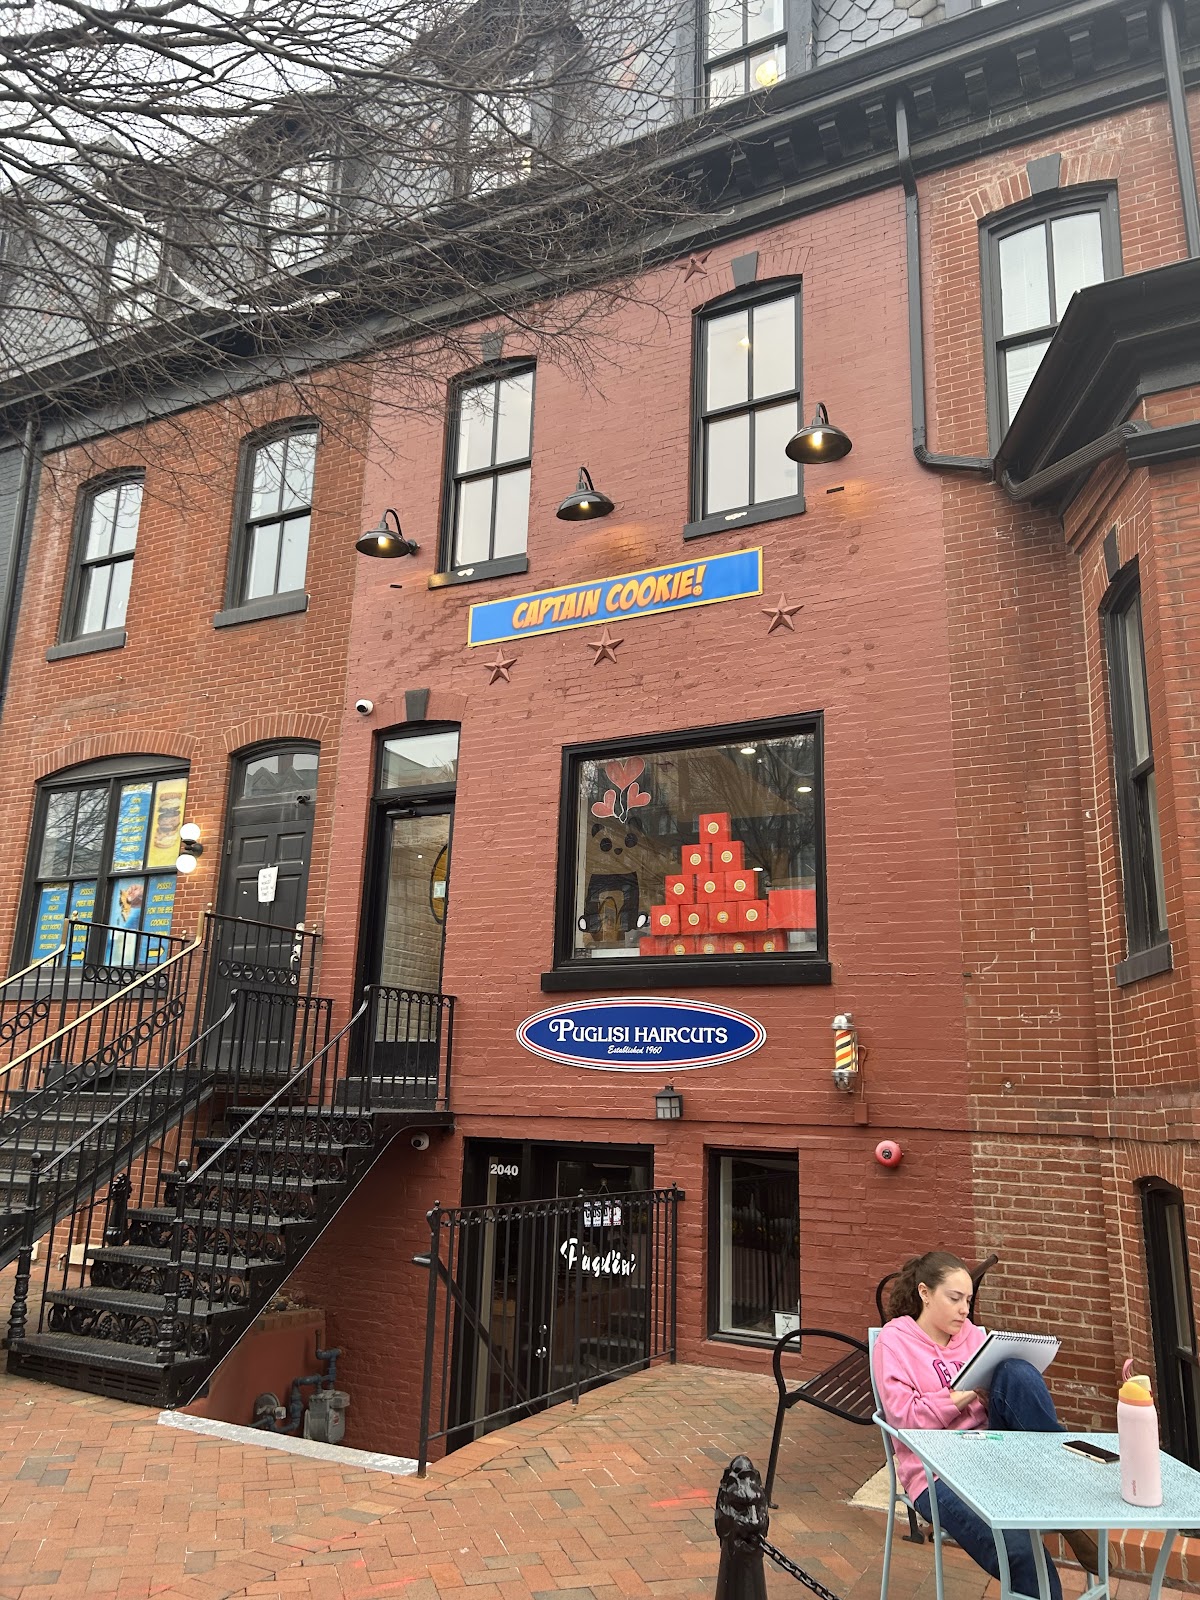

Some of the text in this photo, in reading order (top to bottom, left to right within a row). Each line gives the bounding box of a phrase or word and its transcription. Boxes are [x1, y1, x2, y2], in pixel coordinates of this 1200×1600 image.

[512, 564, 707, 629] CAPTAIN COOKIE!
[165, 906, 173, 914] BES
[549, 1018, 729, 1044] PUGLISI HAIRCUTS
[607, 1044, 663, 1055] Established 1960
[490, 1163, 519, 1176] 2040
